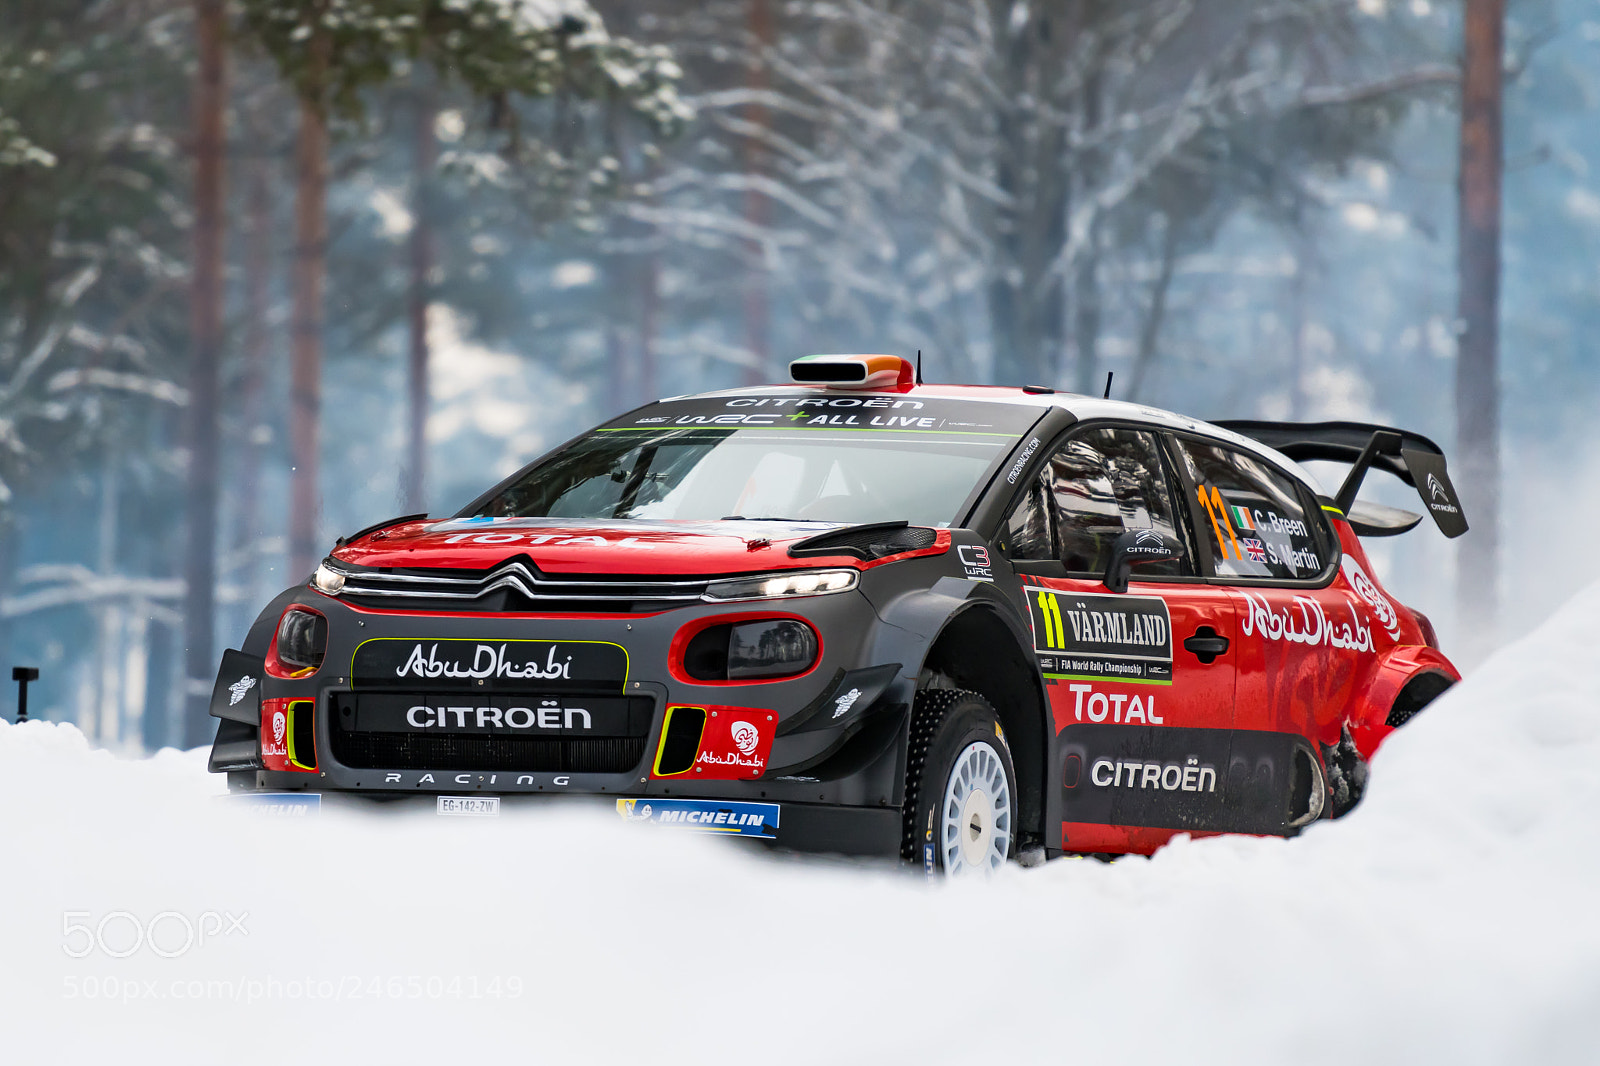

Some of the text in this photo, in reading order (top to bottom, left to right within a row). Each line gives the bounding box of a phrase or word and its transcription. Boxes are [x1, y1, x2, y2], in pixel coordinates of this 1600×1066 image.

[807, 414, 860, 425] ALL
[869, 415, 937, 428] LIVE
[1198, 484, 1243, 561] 11
[1254, 509, 1309, 537] C. Breen
[444, 532, 656, 550] TOTAL
[957, 544, 991, 567] C3
[1266, 542, 1321, 571] S. Martin
[964, 566, 993, 577] WRC
[1037, 590, 1066, 650] 11
[1066, 602, 1166, 647] VÄRMLAND
[1061, 660, 1142, 676] FIA World Rally Championship
[1069, 683, 1164, 724] TOTAL
[443, 800, 494, 813] EG-142-ZW
[660, 810, 765, 826] MICHELIN
